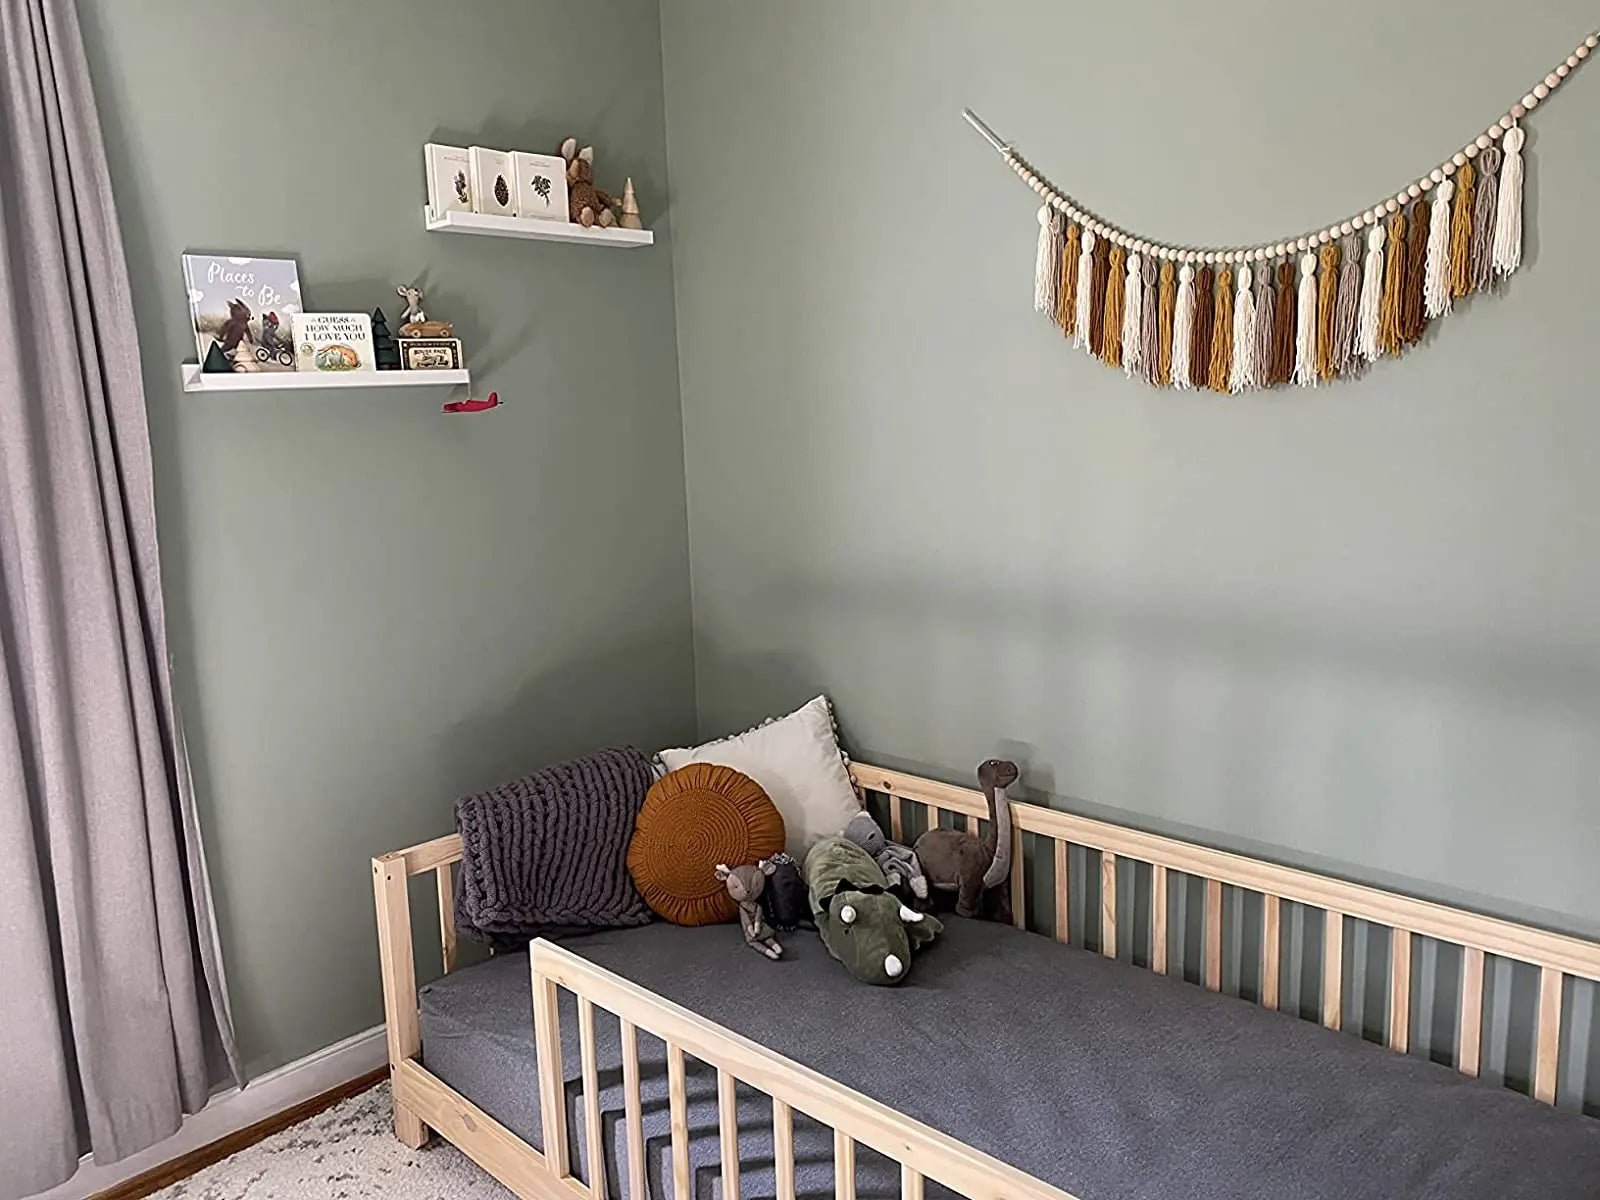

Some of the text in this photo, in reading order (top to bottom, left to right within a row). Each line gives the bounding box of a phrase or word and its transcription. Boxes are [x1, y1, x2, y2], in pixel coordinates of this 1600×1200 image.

[207, 261, 254, 284] Places
[236, 284, 281, 306] to Be
[317, 316, 349, 324] GUESS
[305, 324, 363, 332] HOW MUCH
[305, 333, 366, 341] I LOVE YOU
